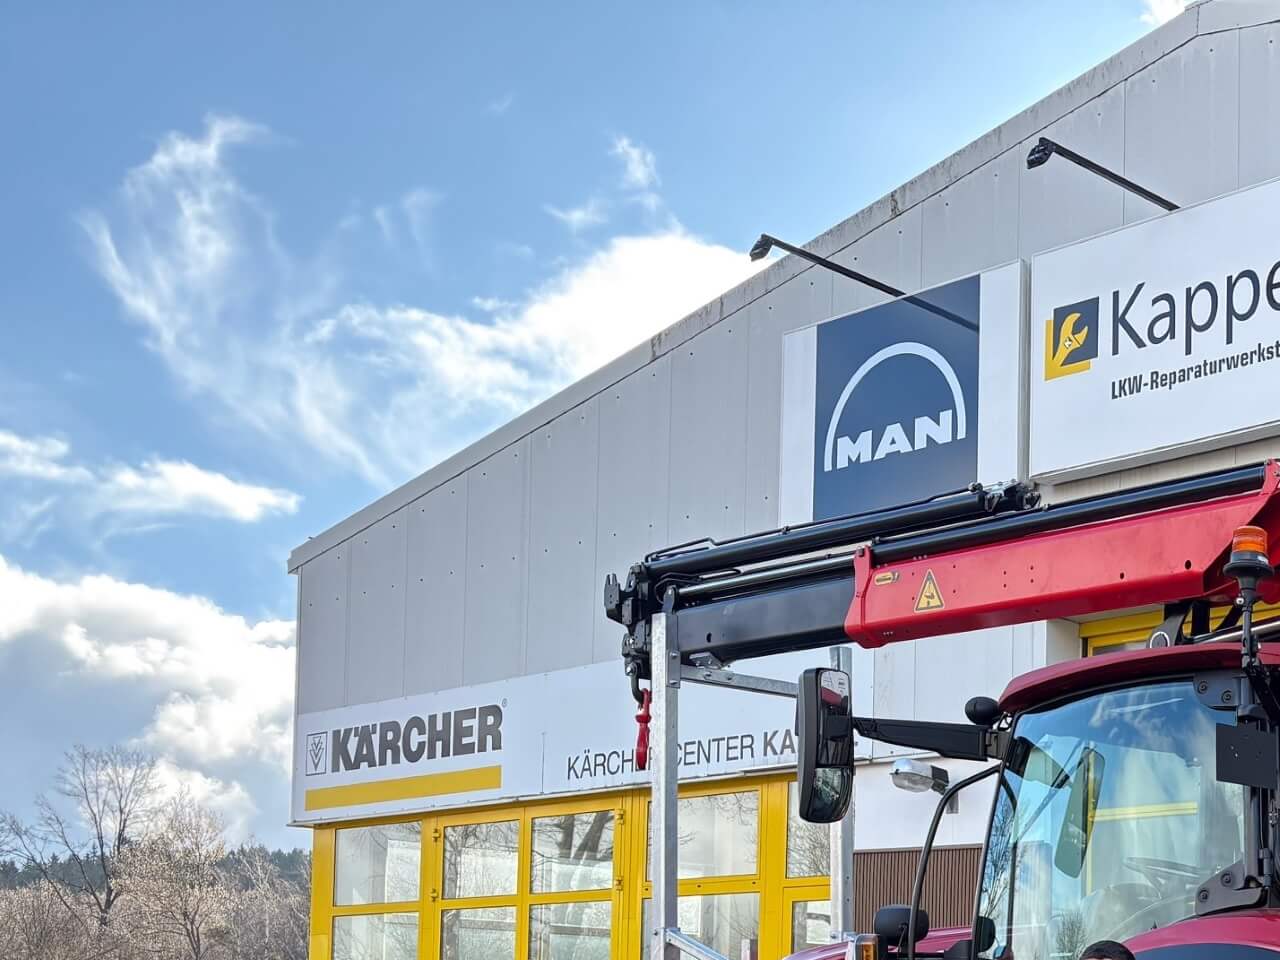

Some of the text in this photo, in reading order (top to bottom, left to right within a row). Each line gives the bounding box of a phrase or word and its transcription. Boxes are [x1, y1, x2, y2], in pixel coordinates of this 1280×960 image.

[836, 409, 953, 470] MAN
[331, 704, 503, 773] KÄRCHER
[567, 749, 653, 780] KÄRCH
